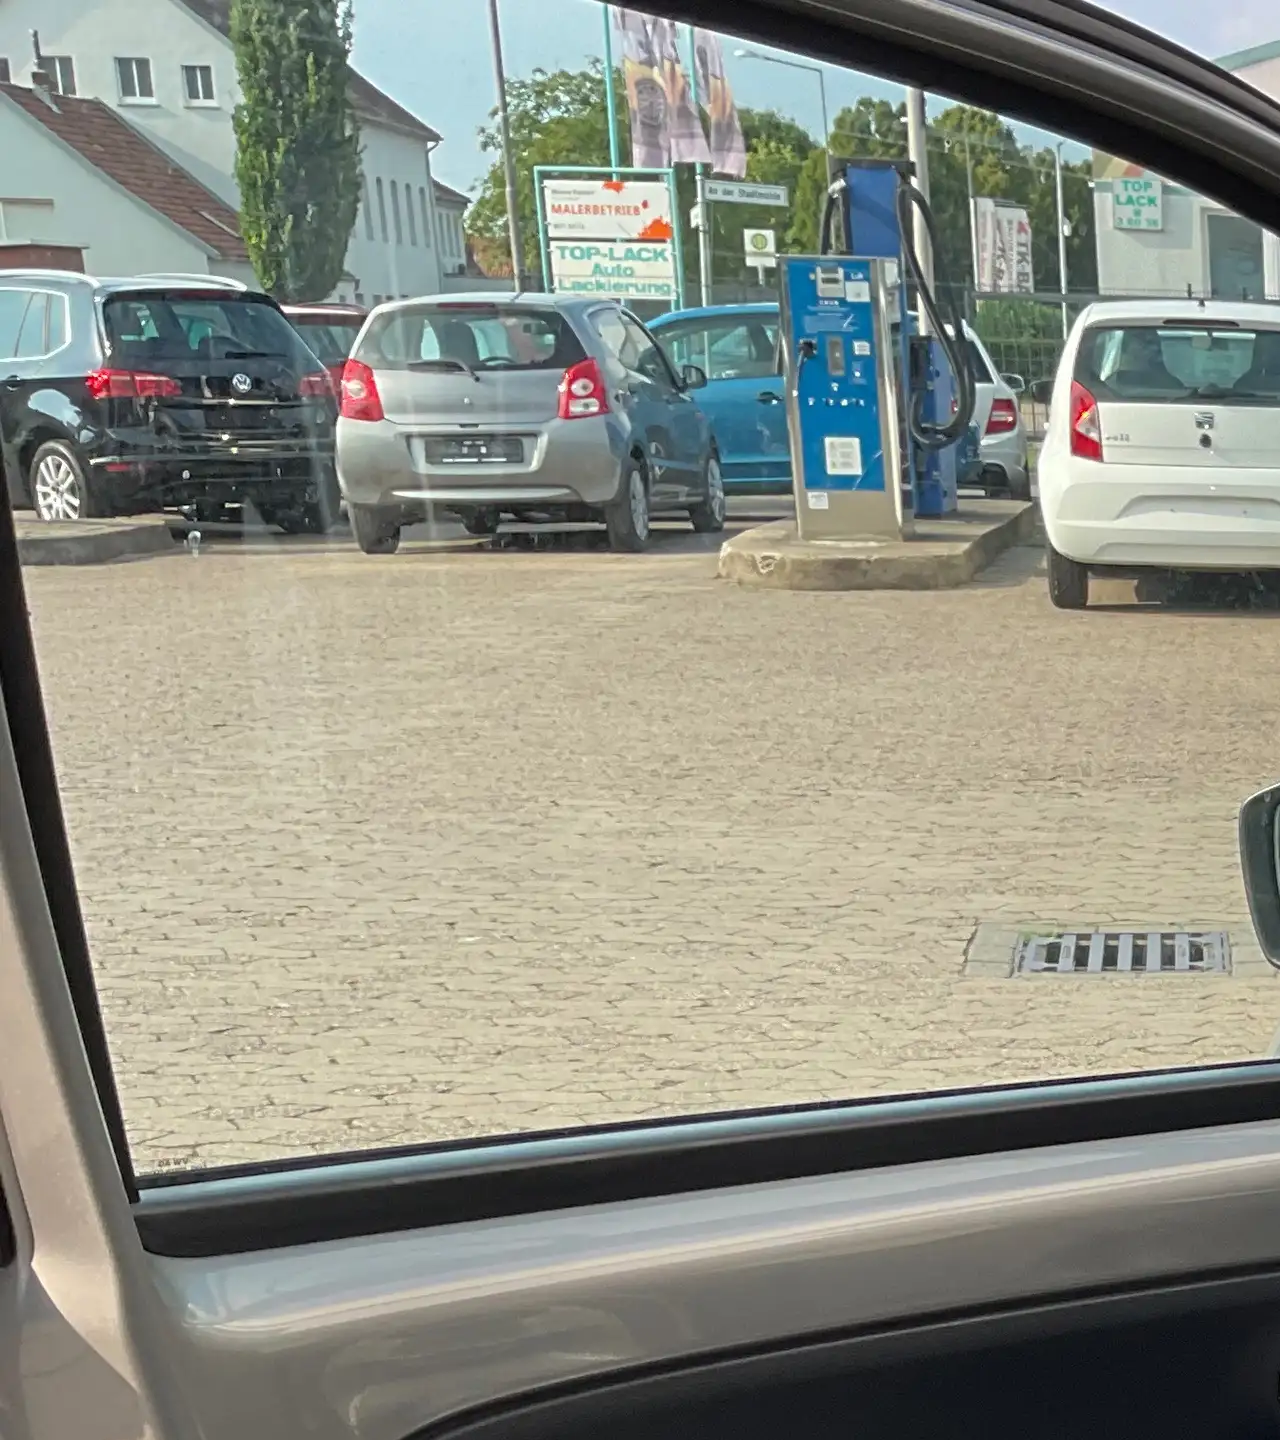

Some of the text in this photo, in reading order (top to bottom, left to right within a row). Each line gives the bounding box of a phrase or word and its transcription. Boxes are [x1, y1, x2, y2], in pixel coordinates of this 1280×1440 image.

[1120, 180, 1153, 192] TOP
[1115, 194, 1158, 207] LACK
[551, 203, 641, 216] MALERBETRIEB
[556, 245, 669, 262] TOP-LACK
[591, 262, 635, 277] Auto
[558, 278, 672, 296] Lackierung
